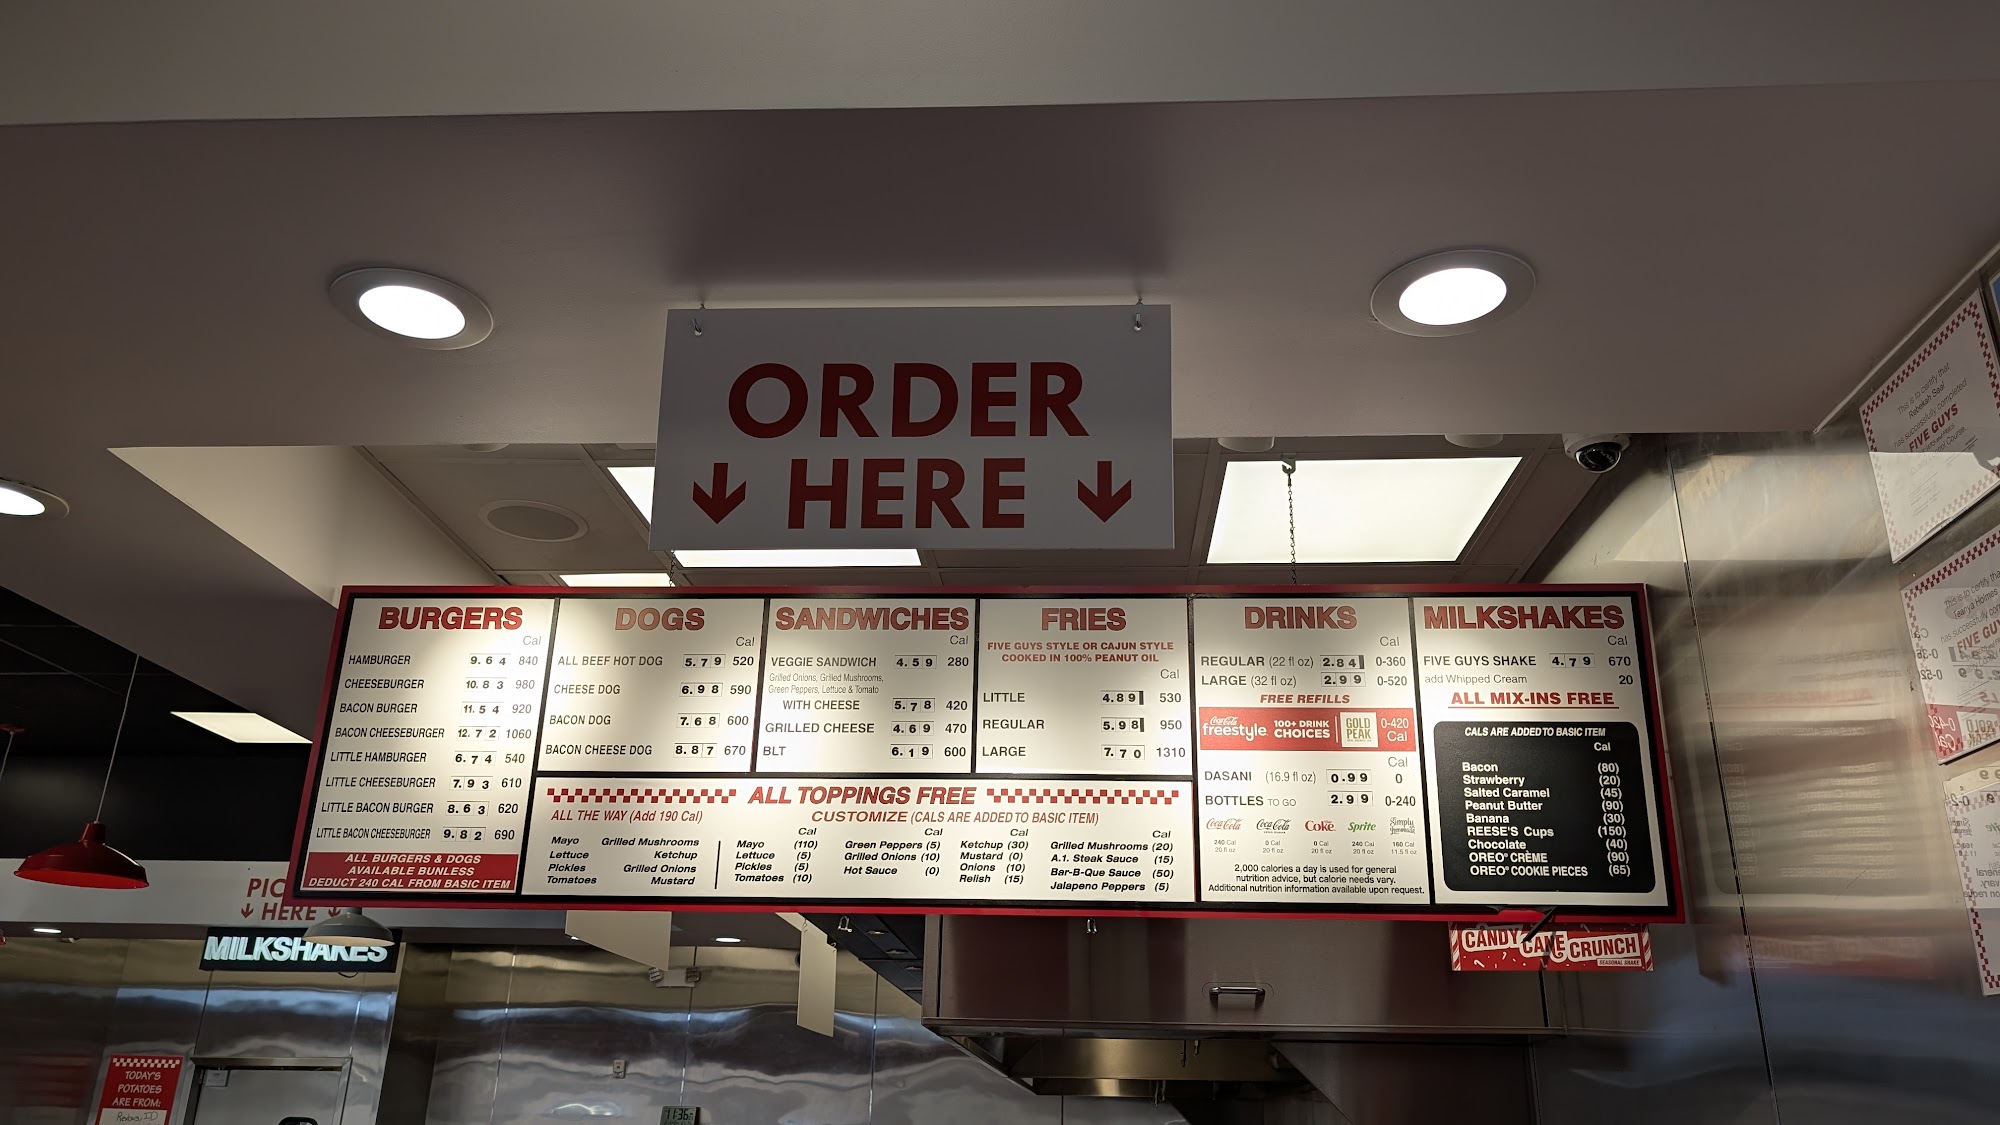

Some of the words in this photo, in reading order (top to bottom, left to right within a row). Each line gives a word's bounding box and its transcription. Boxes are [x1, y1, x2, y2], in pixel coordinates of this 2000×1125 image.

[728, 362, 1089, 438] ORDER
[1909, 428, 1930, 452] FIVE
[1931, 404, 1958, 433] GUYS
[788, 458, 1026, 529] HERE
[379, 607, 523, 630] BURGERS
[615, 608, 705, 630] DOGS
[775, 607, 969, 630] SANDWICHES
[1042, 608, 1126, 631] FRIES
[1245, 606, 1357, 629] DRINKS
[1424, 605, 1624, 629] MILKSHAKES
[736, 637, 754, 647] Cal
[950, 635, 968, 645] Cal
[988, 642, 1011, 650] FIVE
[1014, 642, 1042, 650] GUYS
[1046, 642, 1079, 650] STYLE
[1083, 642, 1097, 650] OR
[1101, 642, 1136, 650] CAJUN
[1140, 642, 1174, 650] STYLE
[349, 655, 410, 664] HAMBURGER
[519, 656, 538, 665] 840
[558, 656, 578, 665] ALL
[582, 656, 610, 665] BEEF
[613, 657, 636, 665] HOT
[639, 657, 663, 666] DOG
[733, 657, 754, 666] 520
[771, 657, 813, 666] VEGGIE
[816, 657, 876, 667] SANDWICH
[948, 657, 969, 666] 280
[1002, 654, 1046, 662] COOKED
[1050, 654, 1060, 662] IN
[1064, 654, 1092, 662] 100%
[1095, 654, 1138, 662] PEANUT
[1141, 654, 1159, 662] OIL
[1201, 656, 1265, 666] REGULAR
[1376, 657, 1405, 667] 0-360
[1424, 656, 1450, 665] FIVE
[1455, 656, 1489, 666] GUYS
[1493, 656, 1536, 666] SHAKE
[1609, 657, 1631, 666] 670
[345, 679, 424, 689] CHEESEBURGER
[515, 680, 535, 689] 980
[1202, 676, 1247, 685] LARGE
[1377, 676, 1407, 686] 0-520
[984, 693, 1025, 702] LITTLE
[1160, 693, 1181, 703] 530
[1260, 695, 1293, 703] FREE
[1297, 695, 1350, 703] REFILLS
[1451, 692, 1484, 704] ALL
[1491, 692, 1561, 705] MIX-INS
[1567, 693, 1614, 705] FREE
[765, 723, 819, 733] GRILLED
[823, 723, 874, 733] CHEESE
[945, 724, 967, 733] 470
[983, 720, 1045, 729] REGULAR
[1160, 720, 1182, 730] 950
[1346, 718, 1370, 728] GOLD
[1274, 729, 1330, 738] CHOICES
[1347, 729, 1371, 739] PEAK
[546, 745, 581, 754] BACON
[585, 745, 626, 755] CHEESE
[629, 746, 652, 755] DOG
[983, 747, 1026, 756] LARGE
[331, 752, 362, 762] LITTLE
[365, 753, 426, 762] HAMBURGER
[505, 754, 525, 763] 540
[1462, 762, 1498, 772] Bacon
[1598, 762, 1619, 774] (80)
[1205, 771, 1252, 781] DASANI
[1463, 775, 1525, 786] Strawberry
[1599, 775, 1620, 787] (20)
[326, 777, 357, 787] LITTLE
[359, 778, 435, 787] CHEESEBURGER
[501, 778, 522, 788] 610
[748, 787, 792, 804] ALL
[798, 787, 911, 805] TOPPINGS
[916, 787, 977, 804] FREE
[1464, 788, 1500, 797] Salted
[1503, 788, 1550, 798] Caramel
[1600, 788, 1622, 799] (45)
[1205, 796, 1264, 806] BOTTLES
[1385, 796, 1416, 806] 0-240
[1465, 801, 1504, 810] Peanut
[1508, 801, 1543, 811] Butter
[321, 802, 353, 812] LITTLE
[356, 803, 390, 813] BACON
[393, 803, 433, 813] BURGER
[498, 804, 518, 813] 620
[551, 810, 573, 820] ALL
[577, 810, 600, 821] THE
[604, 811, 628, 821] WAY
[811, 811, 908, 822] CUSTOMIZE
[1466, 814, 1509, 823] Banana
[1603, 813, 1625, 825] (30)
[1348, 822, 1376, 832] Sprite
[317, 828, 341, 837] LITTLE
[343, 828, 369, 838] BACON
[371, 829, 430, 839] CHEESEBURGER
[494, 830, 515, 840] 690
[551, 837, 579, 847] Mayo
[601, 838, 635, 846] Grilled
[638, 838, 699, 846] Mushrooms
[845, 841, 877, 849] Green
[879, 841, 923, 851] Peppers
[926, 841, 940, 850] (5)
[1468, 840, 1526, 849] Chocolate
[1606, 839, 1628, 851] (40)
[345, 854, 368, 863] ALL
[372, 855, 431, 863] BURGERS
[434, 855, 442, 863] &
[446, 855, 481, 864] DOGS
[550, 851, 589, 859] Lettuce
[654, 851, 697, 860] Ketchup
[1073, 854, 1104, 863] Steak
[1106, 855, 1138, 863] Sauce
[348, 867, 414, 875] AVAILABLE
[418, 867, 474, 876] BUNLESS
[844, 866, 863, 875] Hot
[865, 867, 897, 875] Sauce
[1511, 866, 1550, 876] COOKIE
[1552, 866, 1588, 876] PIECES
[309, 879, 356, 887] DEDUCT
[358, 879, 379, 887] 240
[383, 879, 404, 887] CAL
[408, 879, 442, 888] FROM
[444, 880, 480, 888] BASIC
[482, 880, 510, 888] ITEM
[547, 876, 597, 884] Tomatoes
[651, 877, 695, 885] Mustard
[1051, 882, 1098, 892] Jalapeno
[1101, 882, 1145, 892] Peppers
[1208, 884, 1248, 892] Additional
[1249, 885, 1282, 893] nutrition
[1368, 887, 1389, 895] upon
[1391, 887, 1425, 895] request.
[261, 903, 317, 921] HERE
[1466, 929, 1520, 948] CANDY
[1570, 937, 1636, 958] CRUNCH
[204, 936, 388, 962] MILKSHAKES
[125, 1071, 161, 1080] TODAY'S
[118, 1084, 162, 1093] POTATOES
[112, 1098, 131, 1106] ARE
[133, 1098, 161, 1107] FROM:
